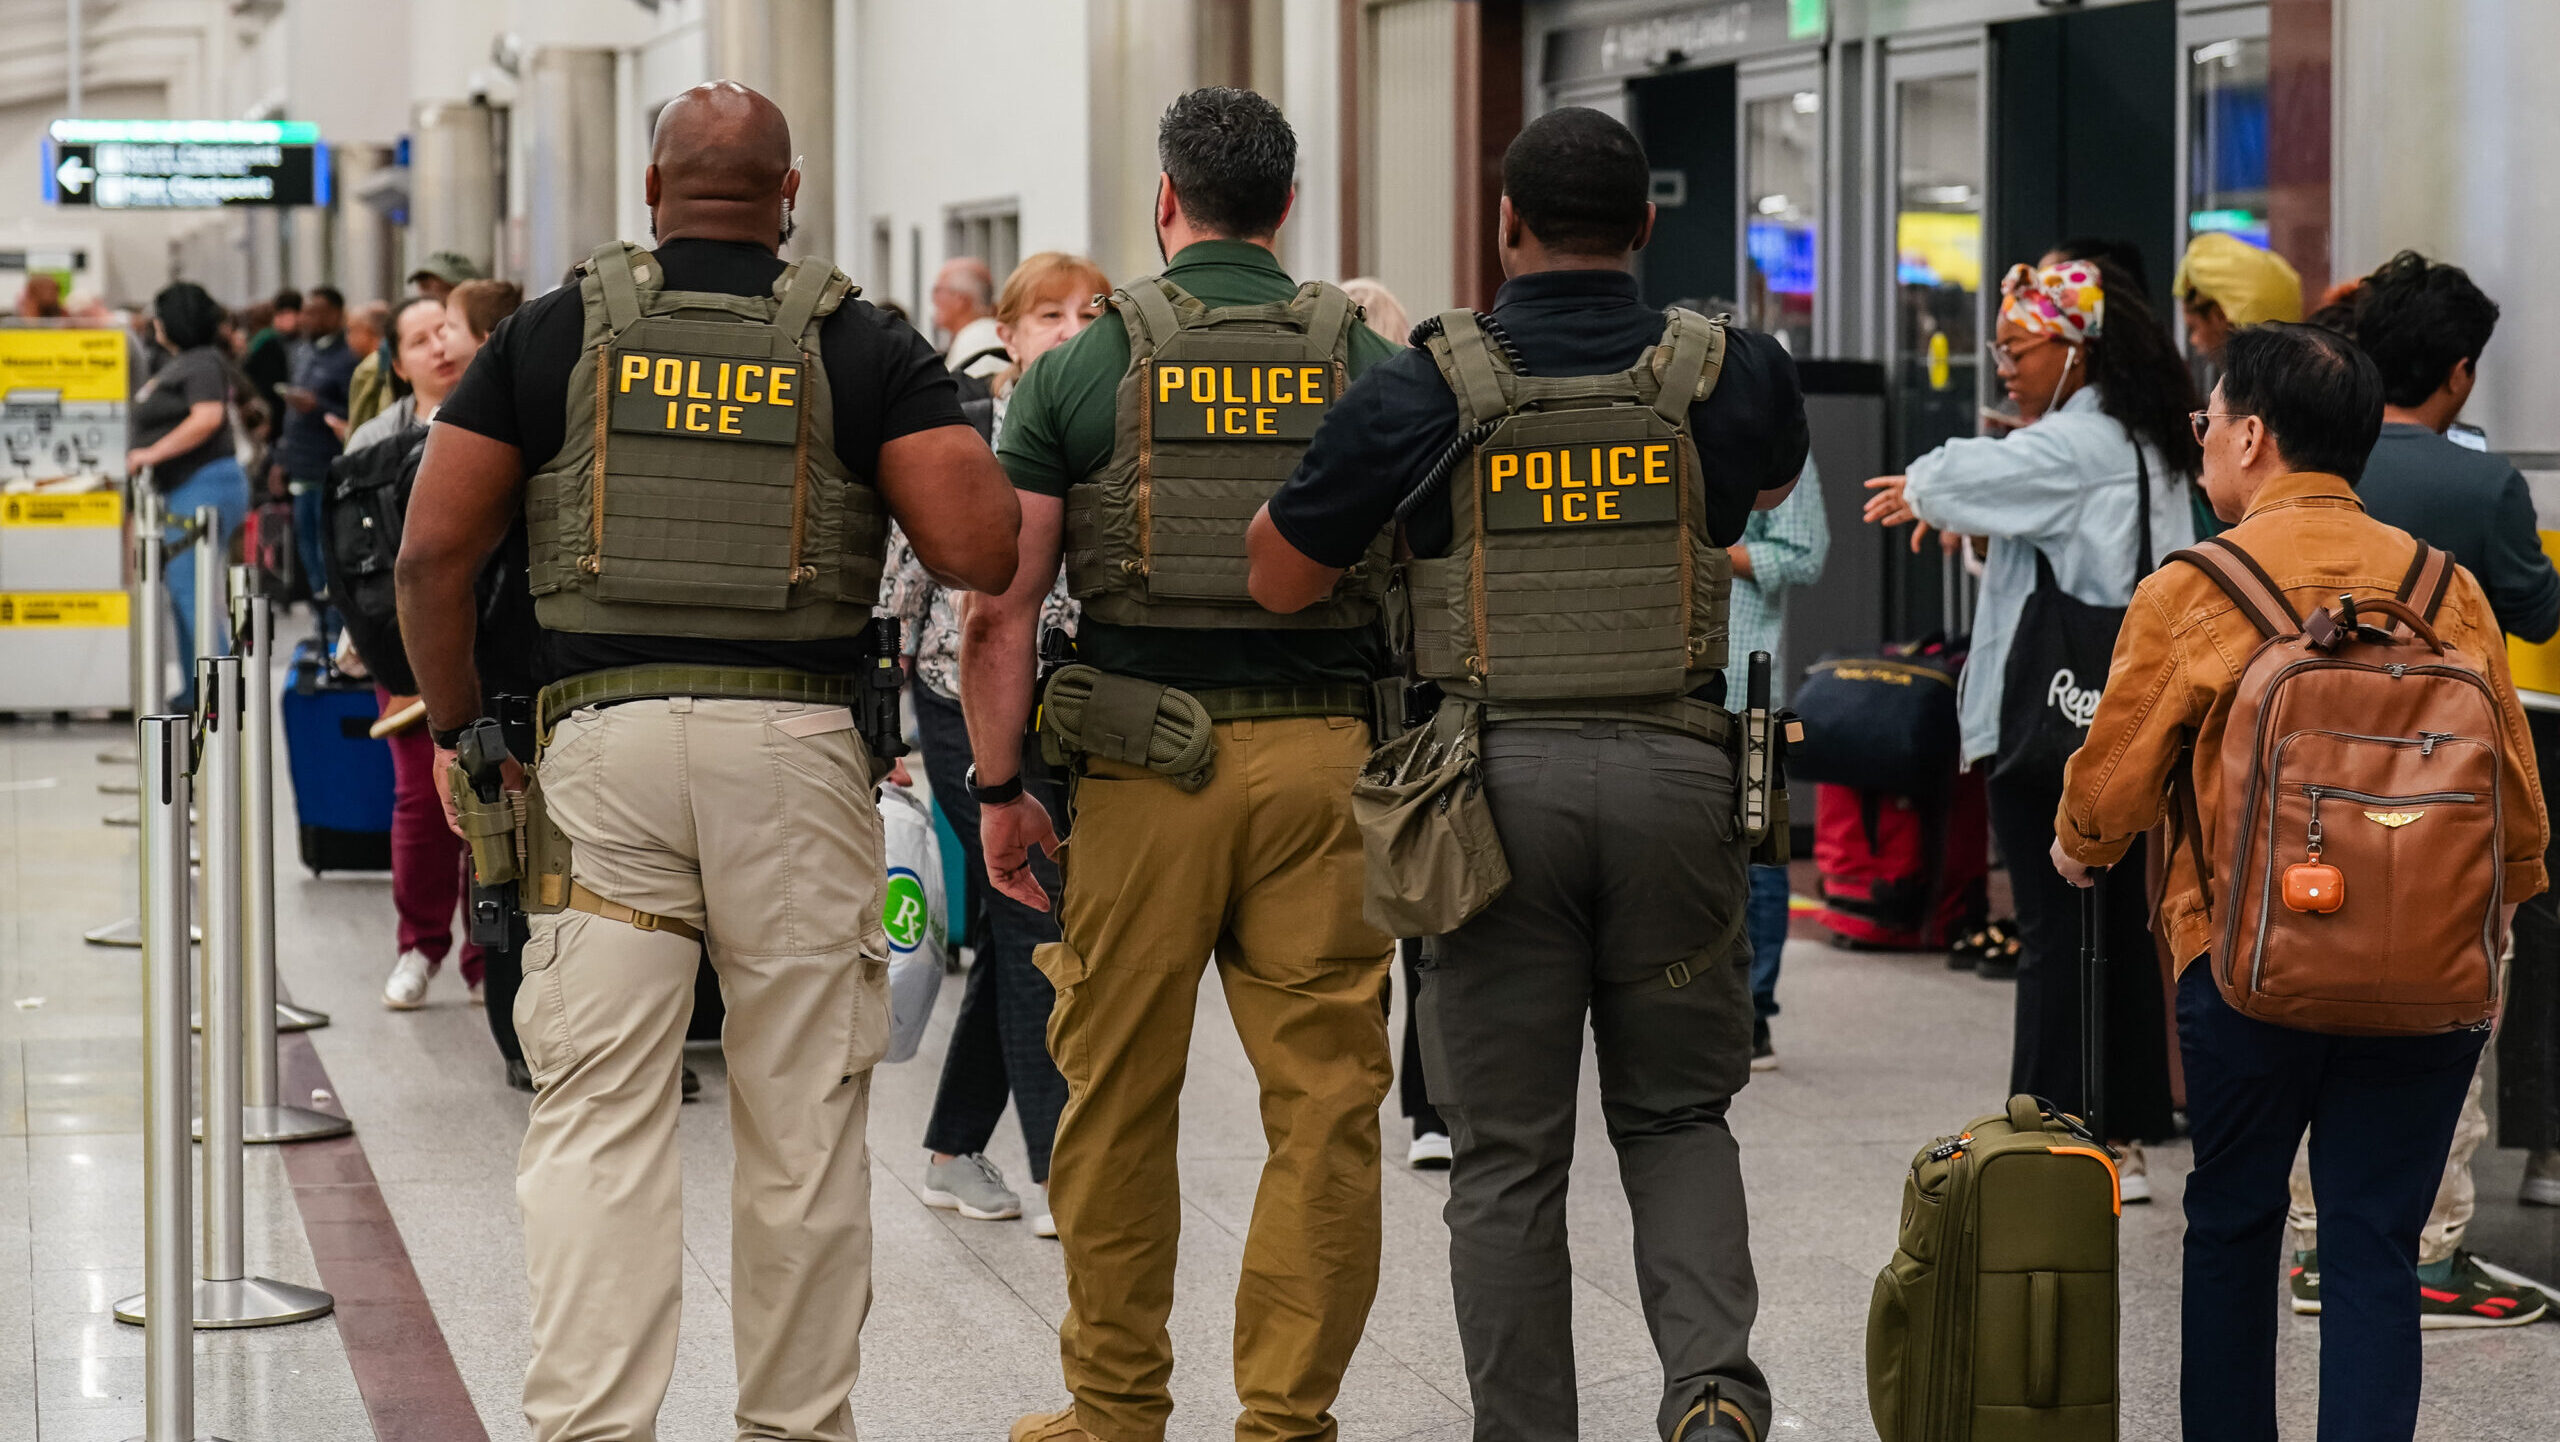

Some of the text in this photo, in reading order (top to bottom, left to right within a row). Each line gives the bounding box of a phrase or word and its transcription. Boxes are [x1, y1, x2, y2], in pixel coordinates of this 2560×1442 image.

[619, 354, 798, 407] POLICE
[1158, 365, 1325, 405] POLICE
[665, 400, 745, 436] ICE
[1206, 406, 1279, 436] ICE
[1490, 443, 1671, 493] POLICE
[1542, 489, 1622, 524] ICE
